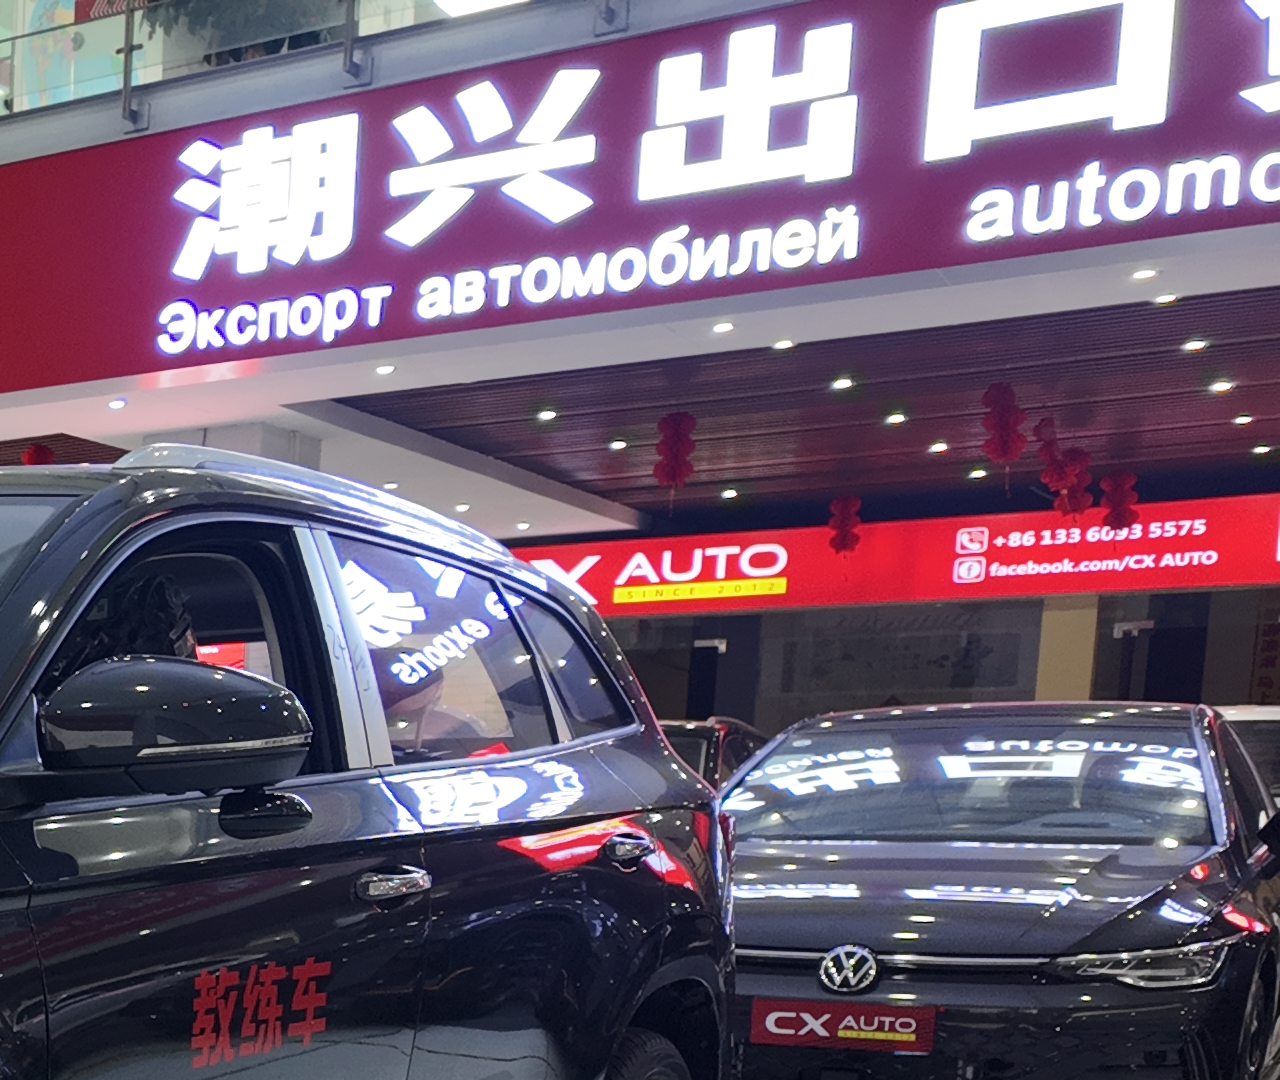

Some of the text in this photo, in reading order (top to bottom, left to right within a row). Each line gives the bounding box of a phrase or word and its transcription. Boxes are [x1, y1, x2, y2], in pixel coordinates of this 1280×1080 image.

[172, 0, 1280, 281] 潮兴出口
[156, 204, 861, 355] Экспорт автомобилей
[993, 530, 1036, 548] +86
[1040, 528, 1082, 546] 133
[1148, 518, 1207, 538] 5575
[614, 542, 789, 586] AUTO
[989, 553, 1156, 578] facebook.com/CX
[1160, 549, 1219, 570] AUTO
[190, 957, 332, 1069] 教练车
[765, 1011, 831, 1037] CX
[838, 1015, 917, 1033] AUTO
